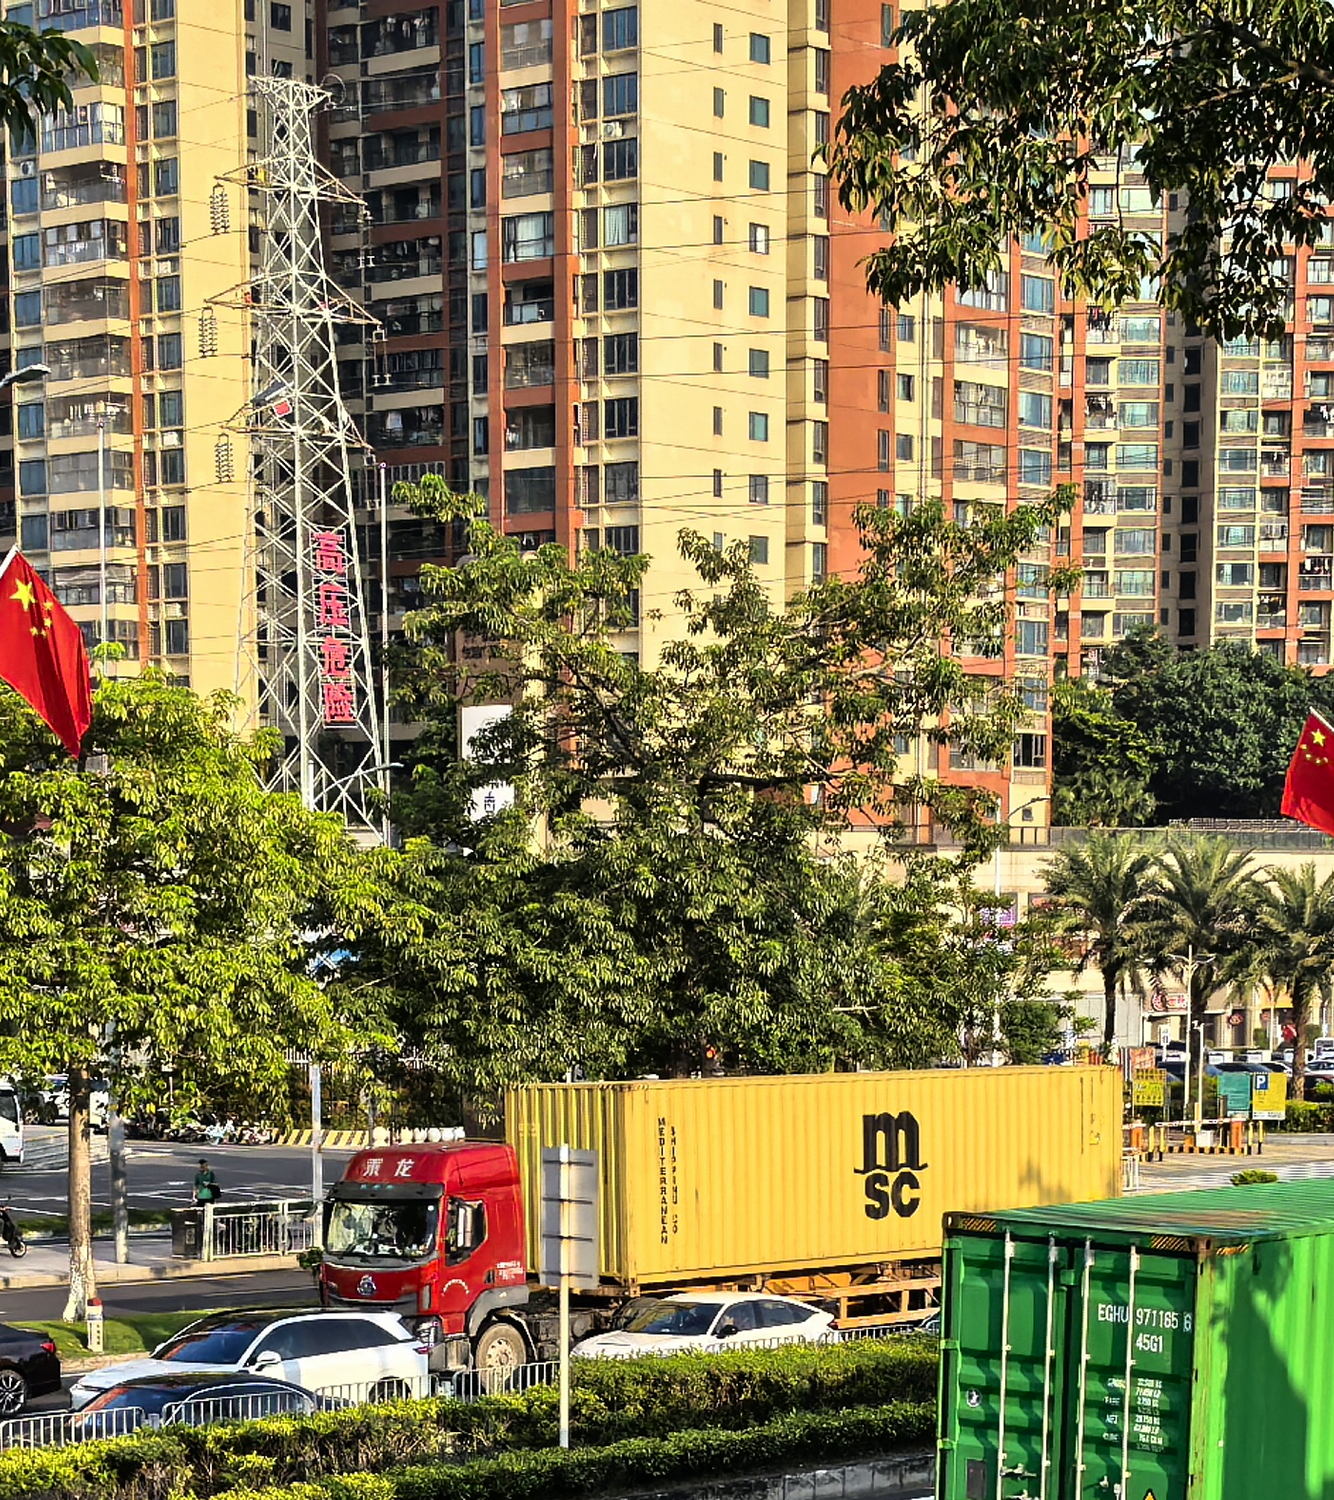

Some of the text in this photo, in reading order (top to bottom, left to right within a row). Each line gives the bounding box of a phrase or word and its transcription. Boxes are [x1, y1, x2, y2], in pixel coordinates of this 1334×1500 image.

[312, 531, 357, 723] 高压危险
[1256, 1075, 1266, 1089] P
[657, 1117, 669, 1244] MEDITERRANEAN
[864, 1171, 921, 1220] SC
[1097, 1303, 1129, 1324] EGHU
[1135, 1307, 1179, 1330] 971165
[1135, 1332, 1164, 1353] 45G1
